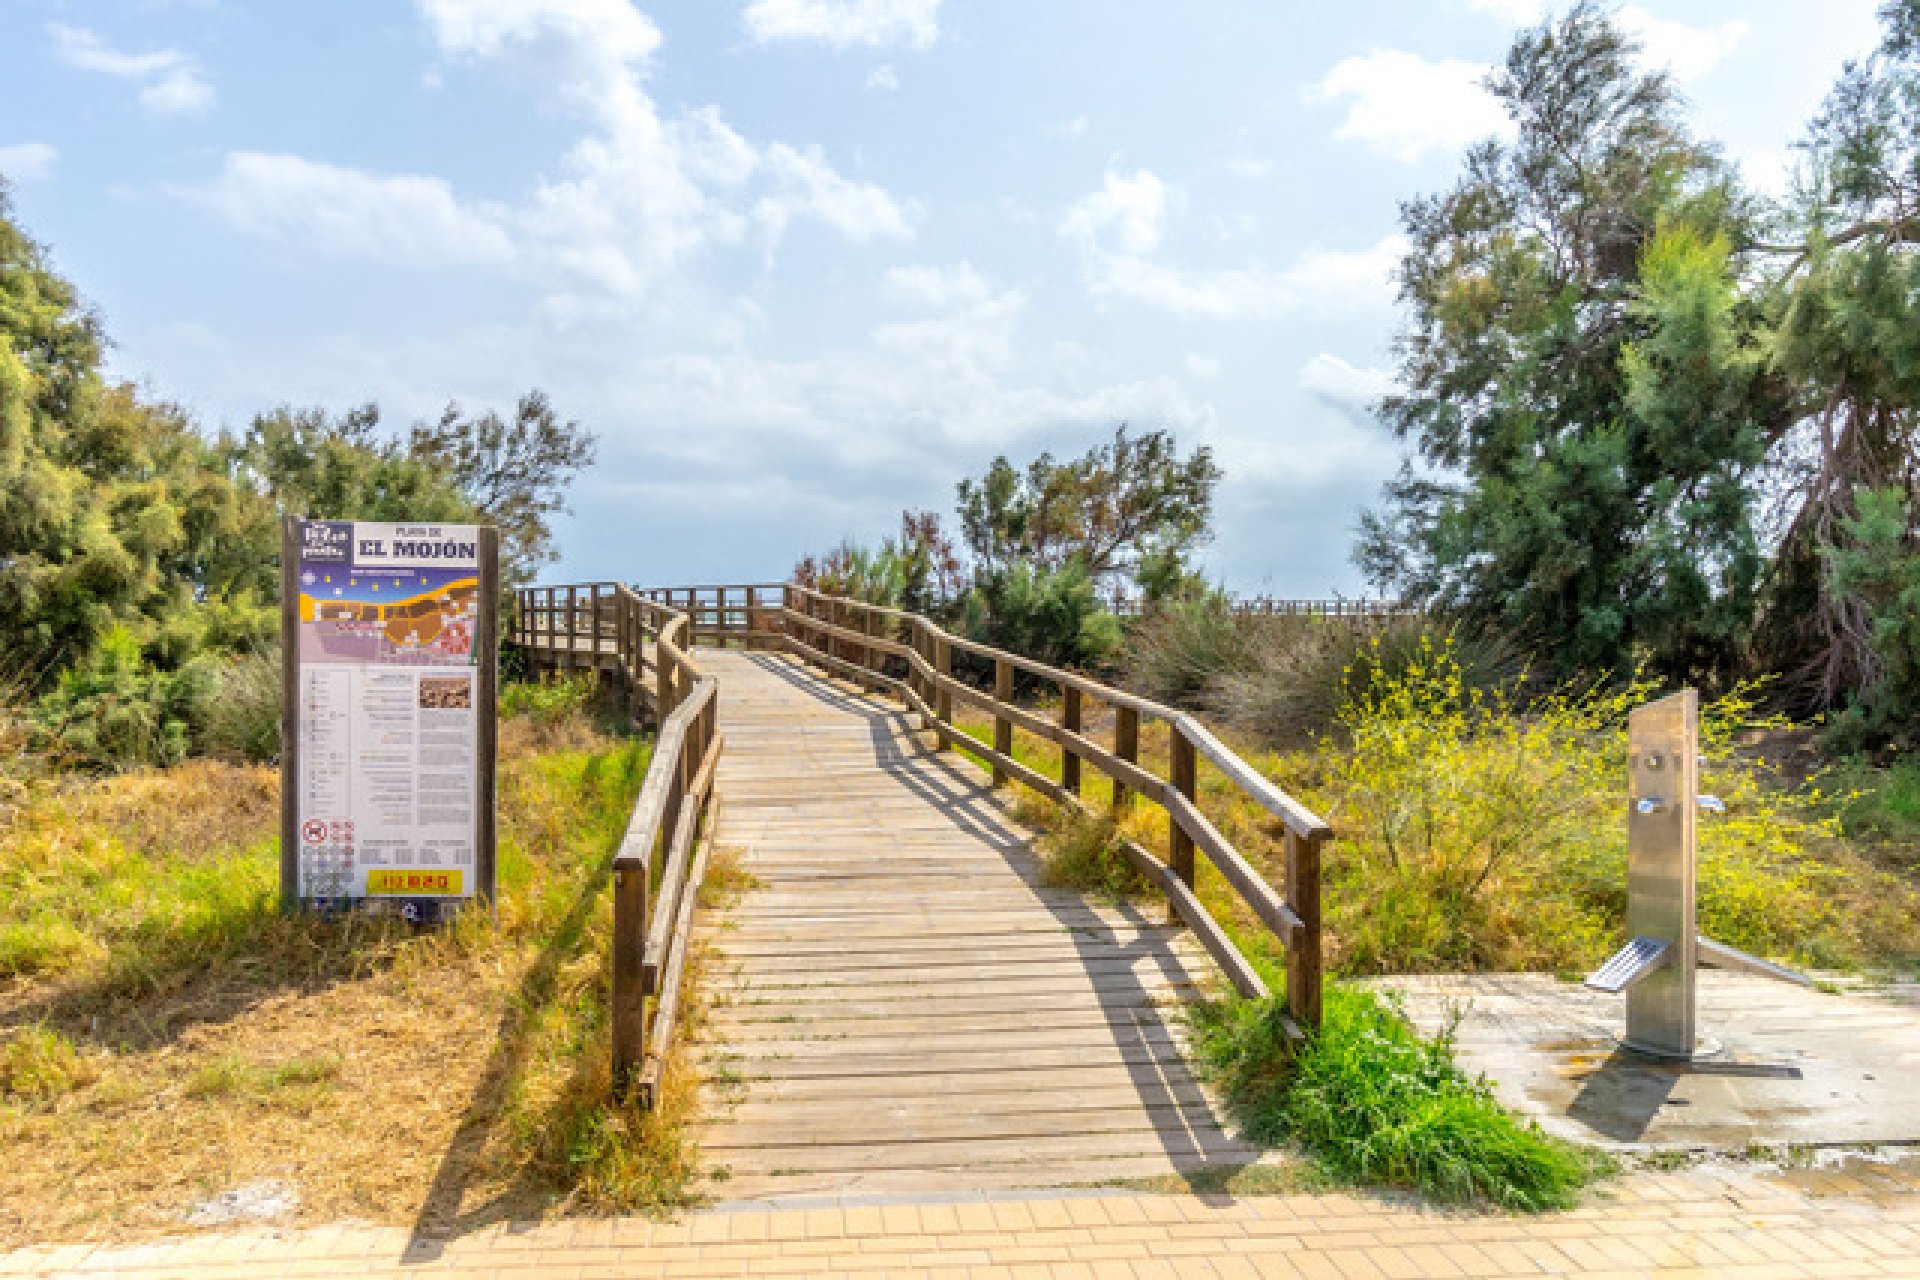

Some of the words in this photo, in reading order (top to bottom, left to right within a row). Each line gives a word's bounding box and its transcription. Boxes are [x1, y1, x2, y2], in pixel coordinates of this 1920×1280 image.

[396, 528, 426, 537] PLAYA
[429, 528, 441, 537] DE
[359, 540, 387, 557] EL
[393, 538, 477, 558] MOJÓN
